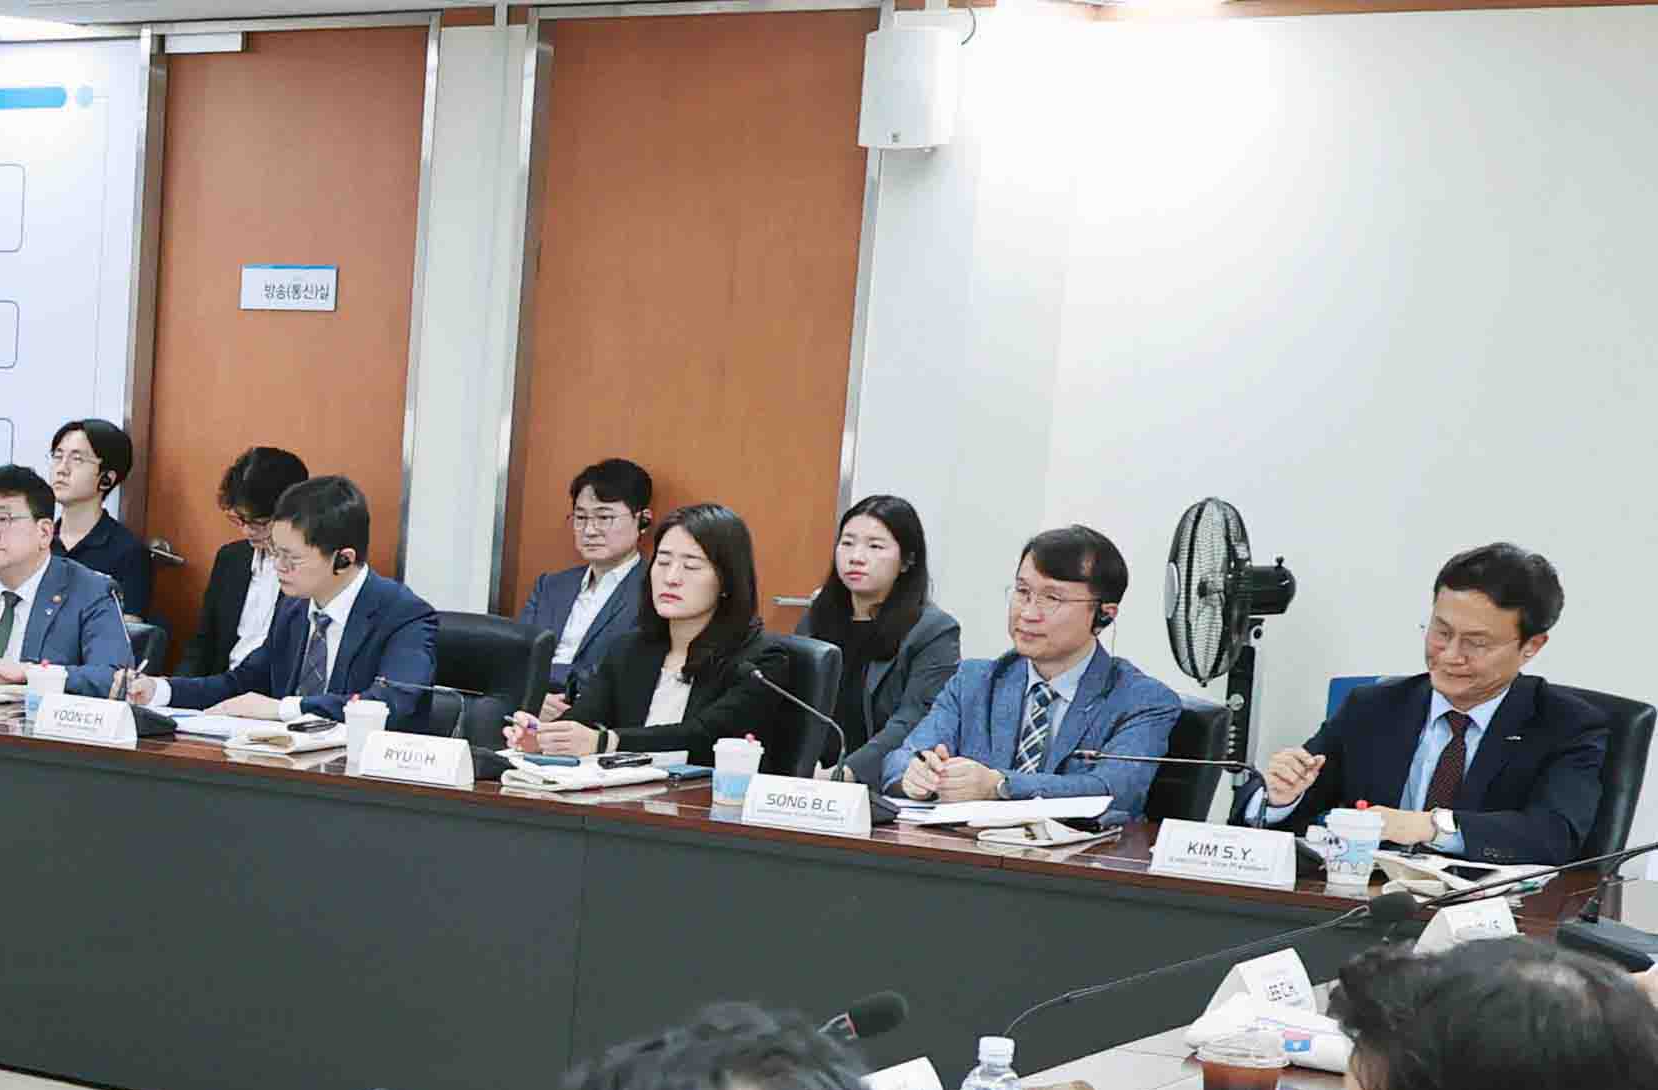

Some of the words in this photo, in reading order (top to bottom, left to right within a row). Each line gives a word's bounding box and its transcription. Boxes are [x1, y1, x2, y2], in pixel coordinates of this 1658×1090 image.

[264, 282, 330, 301] 방송(통신)실
[766, 793, 808, 810] SONG
[1187, 840, 1219, 857] KIM
[1221, 845, 1255, 862] S.Y.
